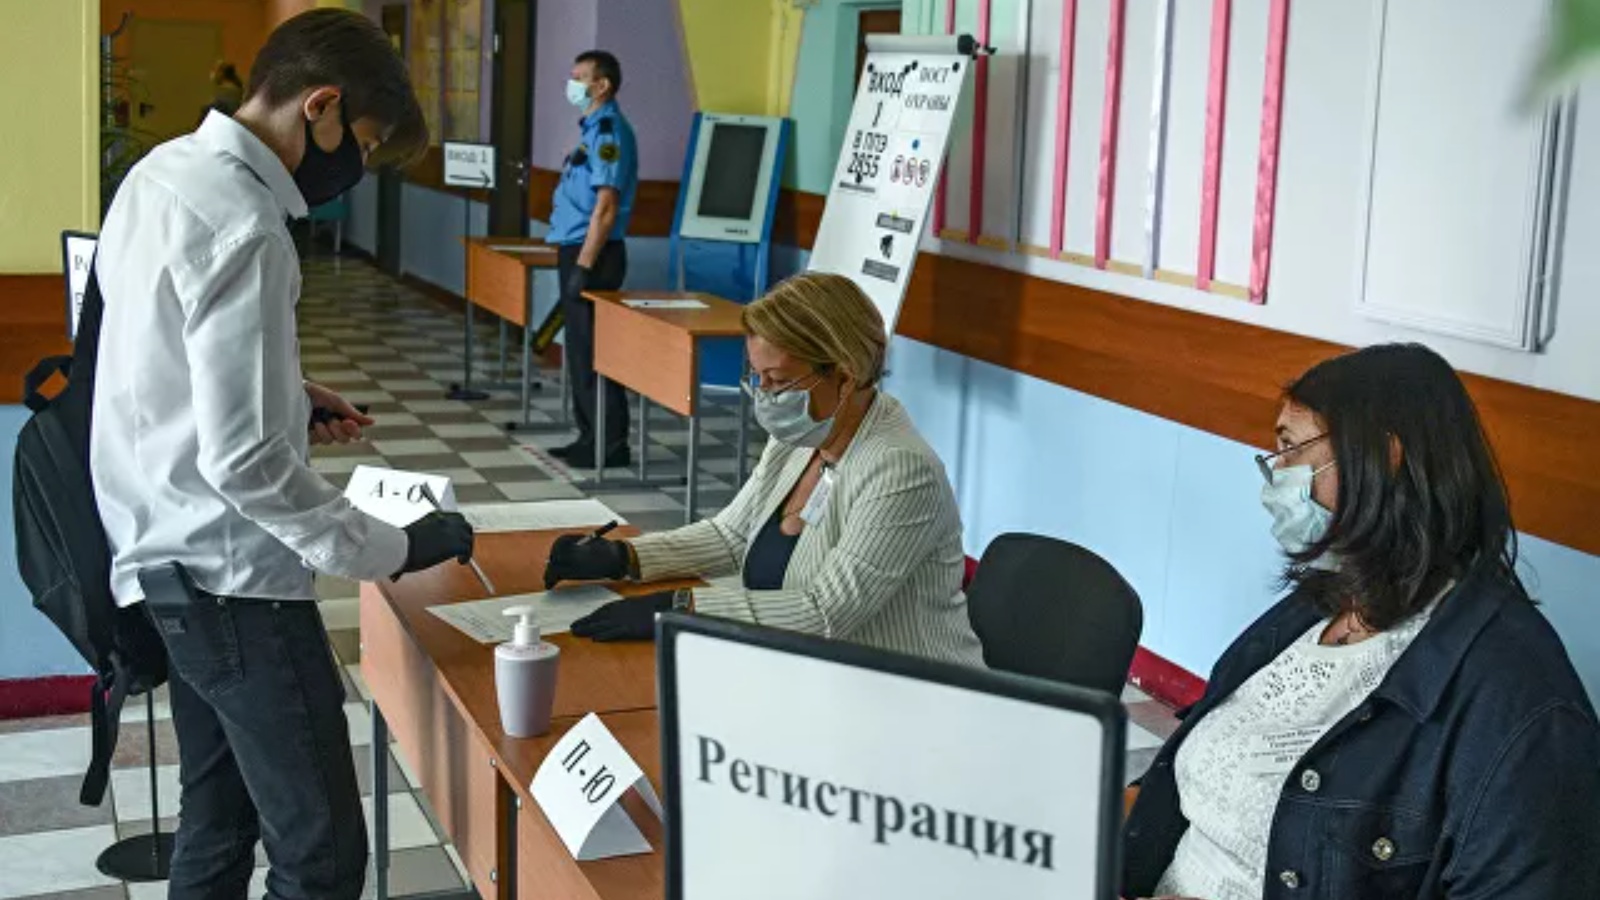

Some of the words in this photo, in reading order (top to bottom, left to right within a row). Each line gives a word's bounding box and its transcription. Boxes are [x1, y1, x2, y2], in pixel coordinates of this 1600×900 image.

[871, 100, 883, 128] 1
[847, 152, 881, 178] 2855
[696, 734, 1057, 870] Регистрация
